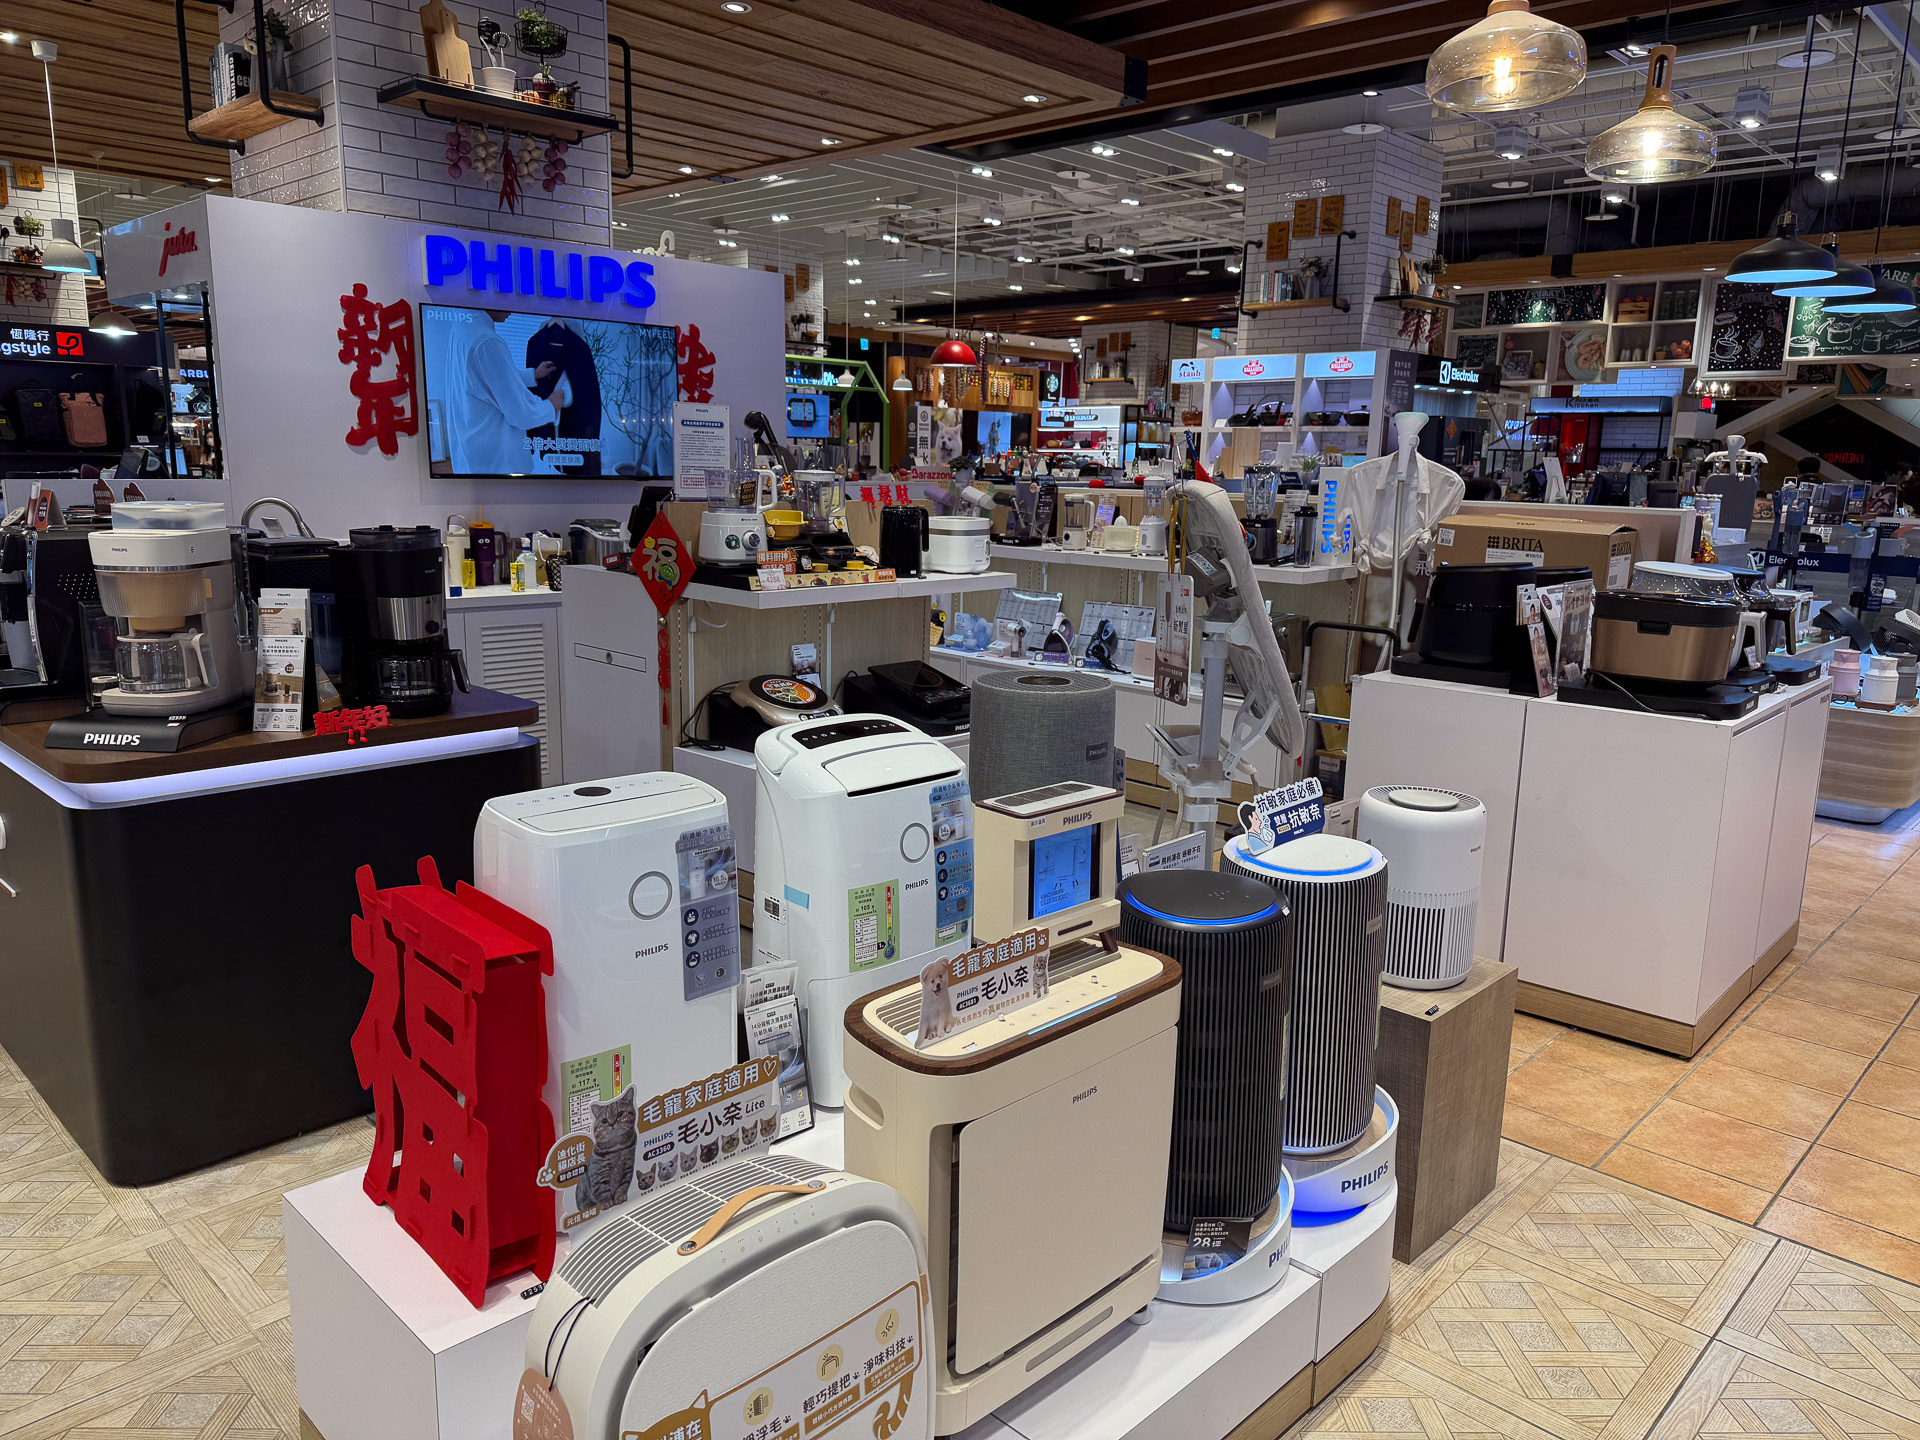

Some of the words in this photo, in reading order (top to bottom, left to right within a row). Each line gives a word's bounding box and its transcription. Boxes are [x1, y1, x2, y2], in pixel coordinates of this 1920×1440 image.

[158, 221, 198, 277] jura
[424, 235, 656, 308] PHILIPS
[426, 309, 473, 324] PHILIPS
[0, 341, 51, 357] gstyle
[1451, 367, 1480, 383] Electrolux
[1321, 480, 1338, 554] PHILIPS
[1501, 536, 1545, 552] BRITA
[83, 732, 142, 747] PHILIPS
[1062, 811, 1093, 826] PHILIPS
[904, 879, 929, 891] PHILIPS
[634, 942, 669, 958] PHILIPS
[952, 932, 1037, 978] 毛寵家庭適用
[981, 965, 1029, 1000] 毛小奈
[957, 985, 979, 999] PHILIPS
[578, 1078, 590, 1087] 117
[642, 1062, 759, 1124] 毛寵家庭適用
[1072, 1085, 1098, 1105] PHILIPS
[677, 1101, 743, 1145] 毛小奈
[745, 1099, 766, 1115] Lite
[643, 1130, 674, 1148] PHILIPS
[647, 1144, 672, 1159] AC3360
[1341, 1160, 1389, 1194] PHILIPS
[863, 1338, 907, 1376] 淨味科技
[802, 1373, 852, 1414] 輕巧提把
